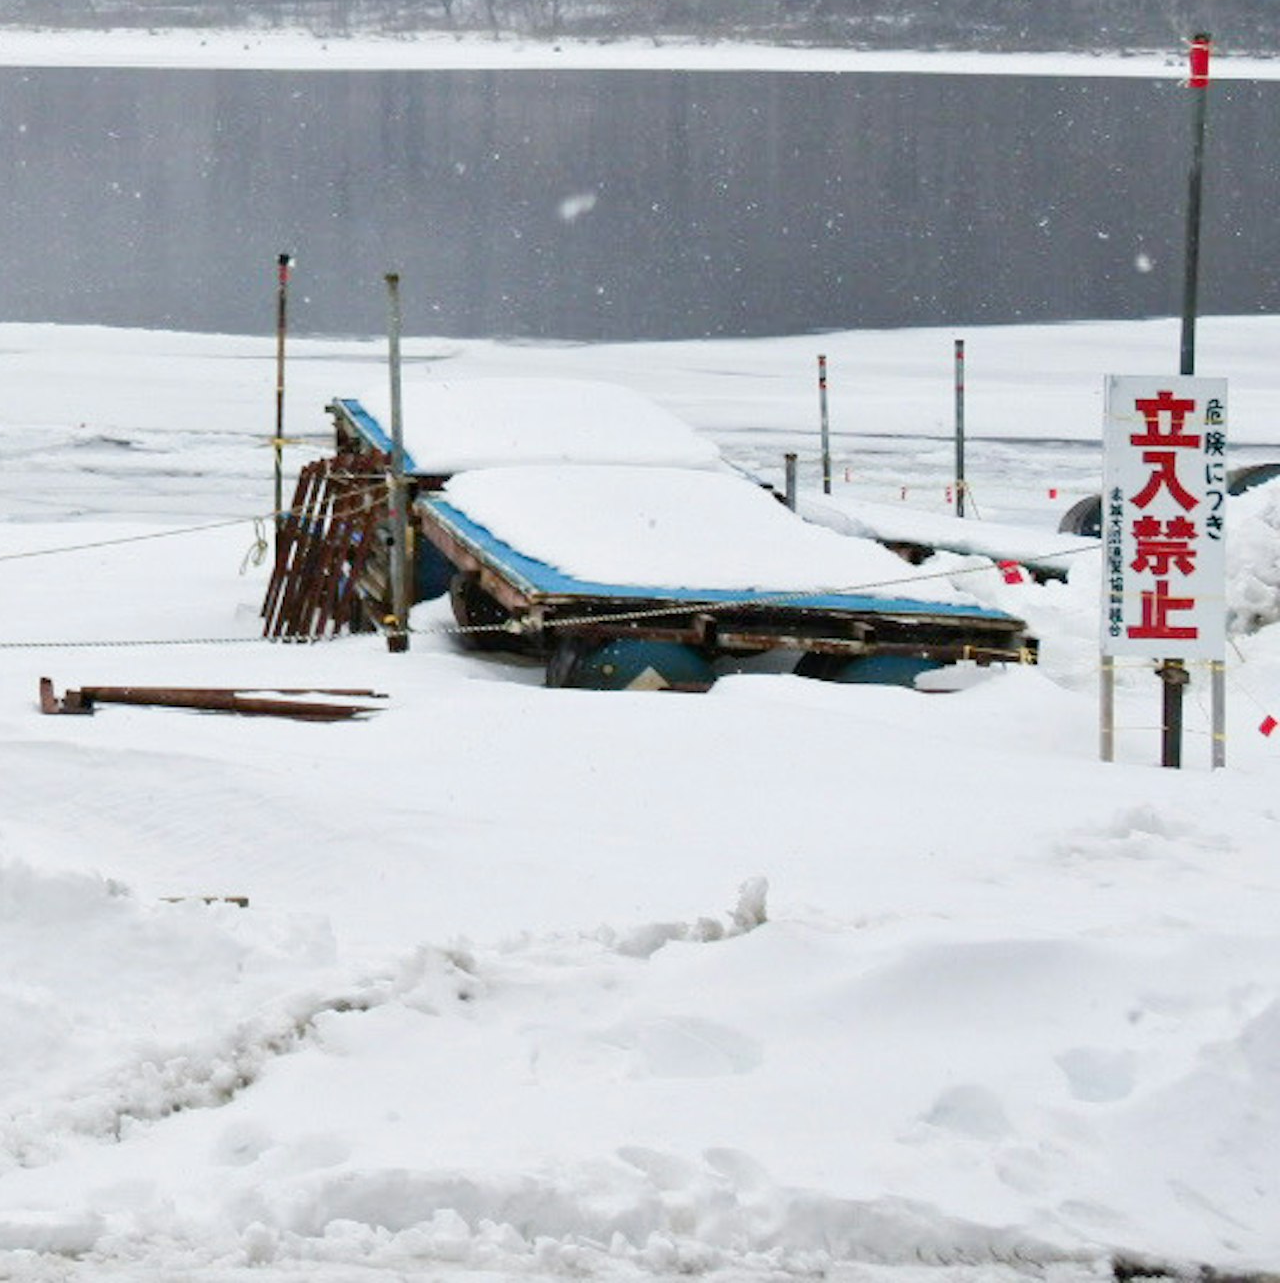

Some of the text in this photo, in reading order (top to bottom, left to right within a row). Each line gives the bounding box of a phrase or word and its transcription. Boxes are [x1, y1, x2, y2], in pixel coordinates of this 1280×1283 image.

[1126, 390, 1202, 640] 立入禁止
[1203, 397, 1226, 541] 危険につき
